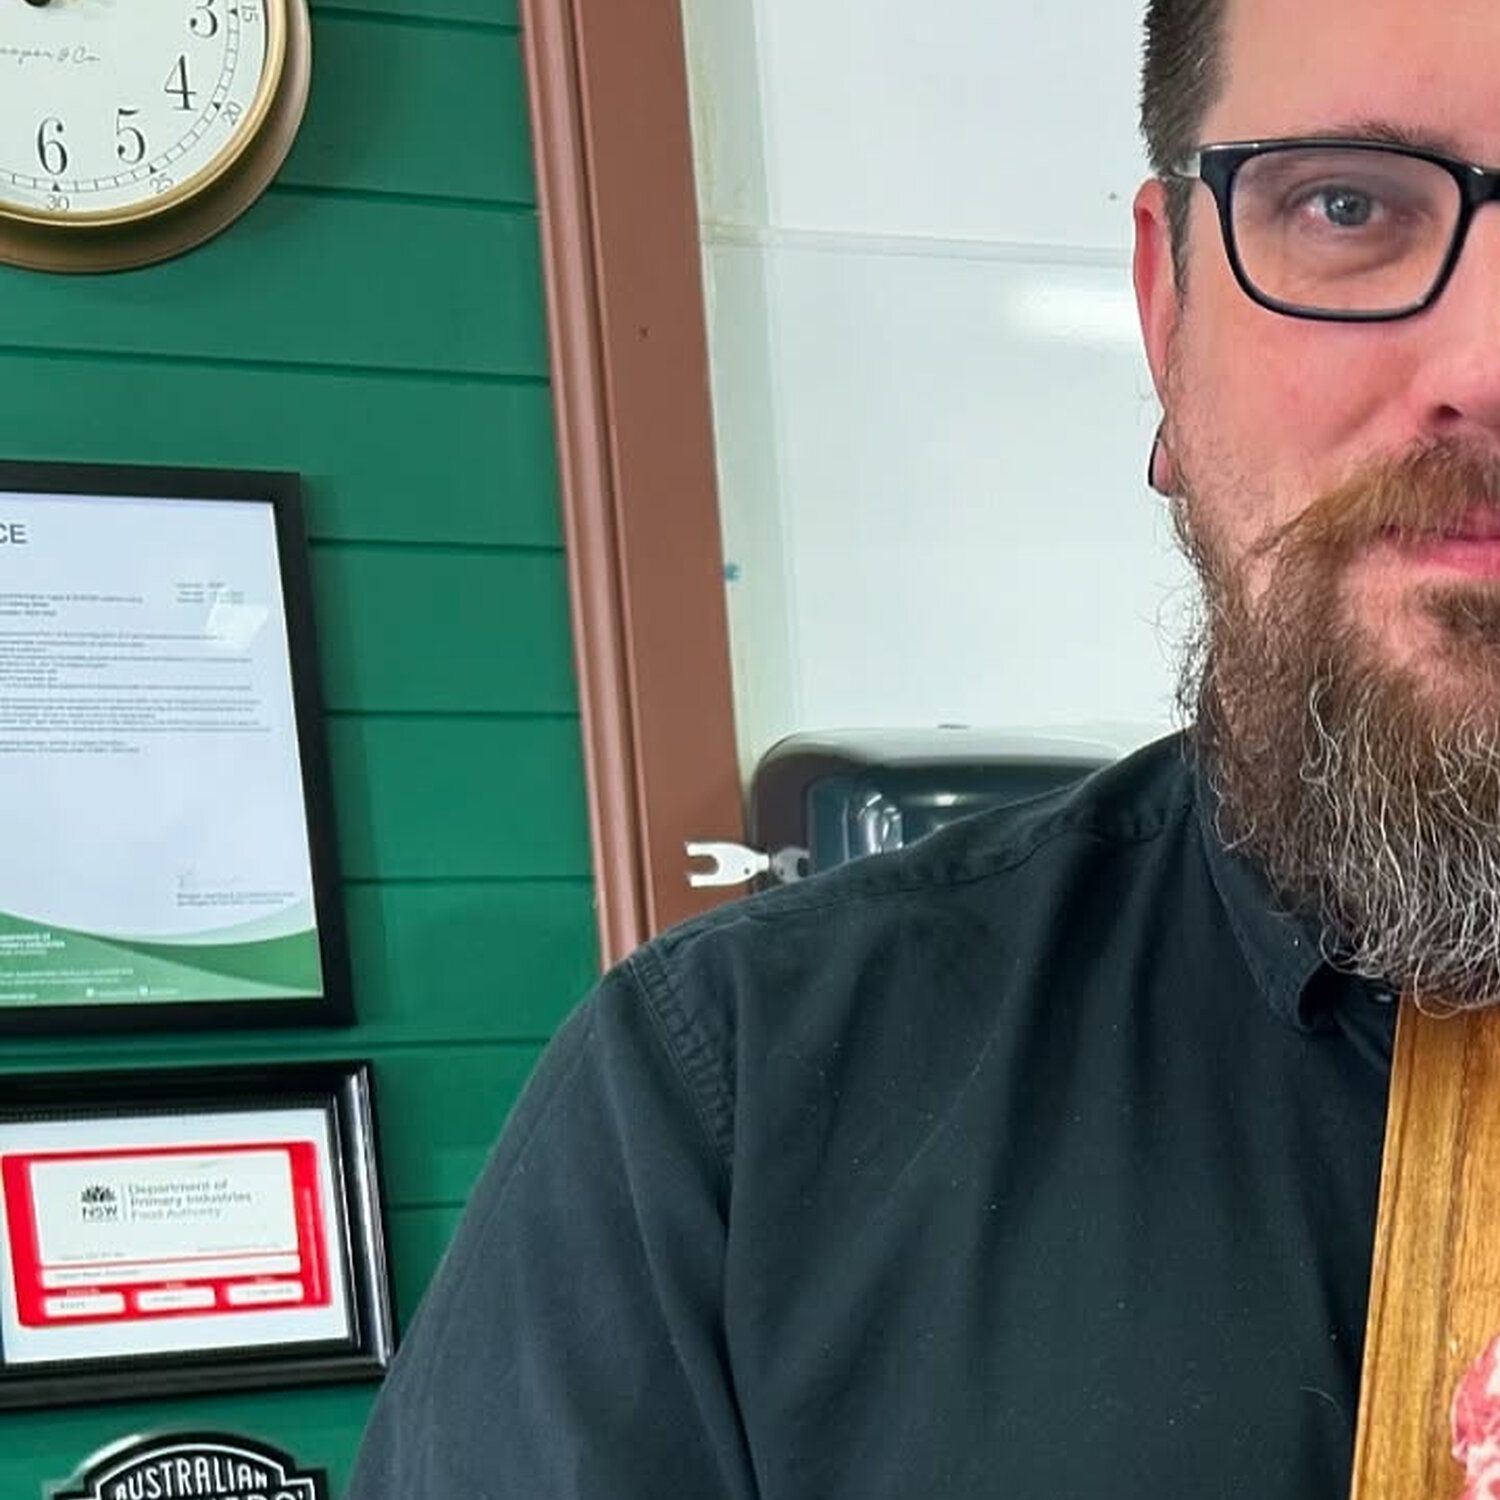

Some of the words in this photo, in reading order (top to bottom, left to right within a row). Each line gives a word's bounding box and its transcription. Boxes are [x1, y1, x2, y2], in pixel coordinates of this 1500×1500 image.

[190, 0, 217, 38] 3
[164, 54, 197, 111] 4
[37, 117, 68, 175] 6
[116, 108, 146, 164] 5
[82, 1204, 118, 1221] NSW
